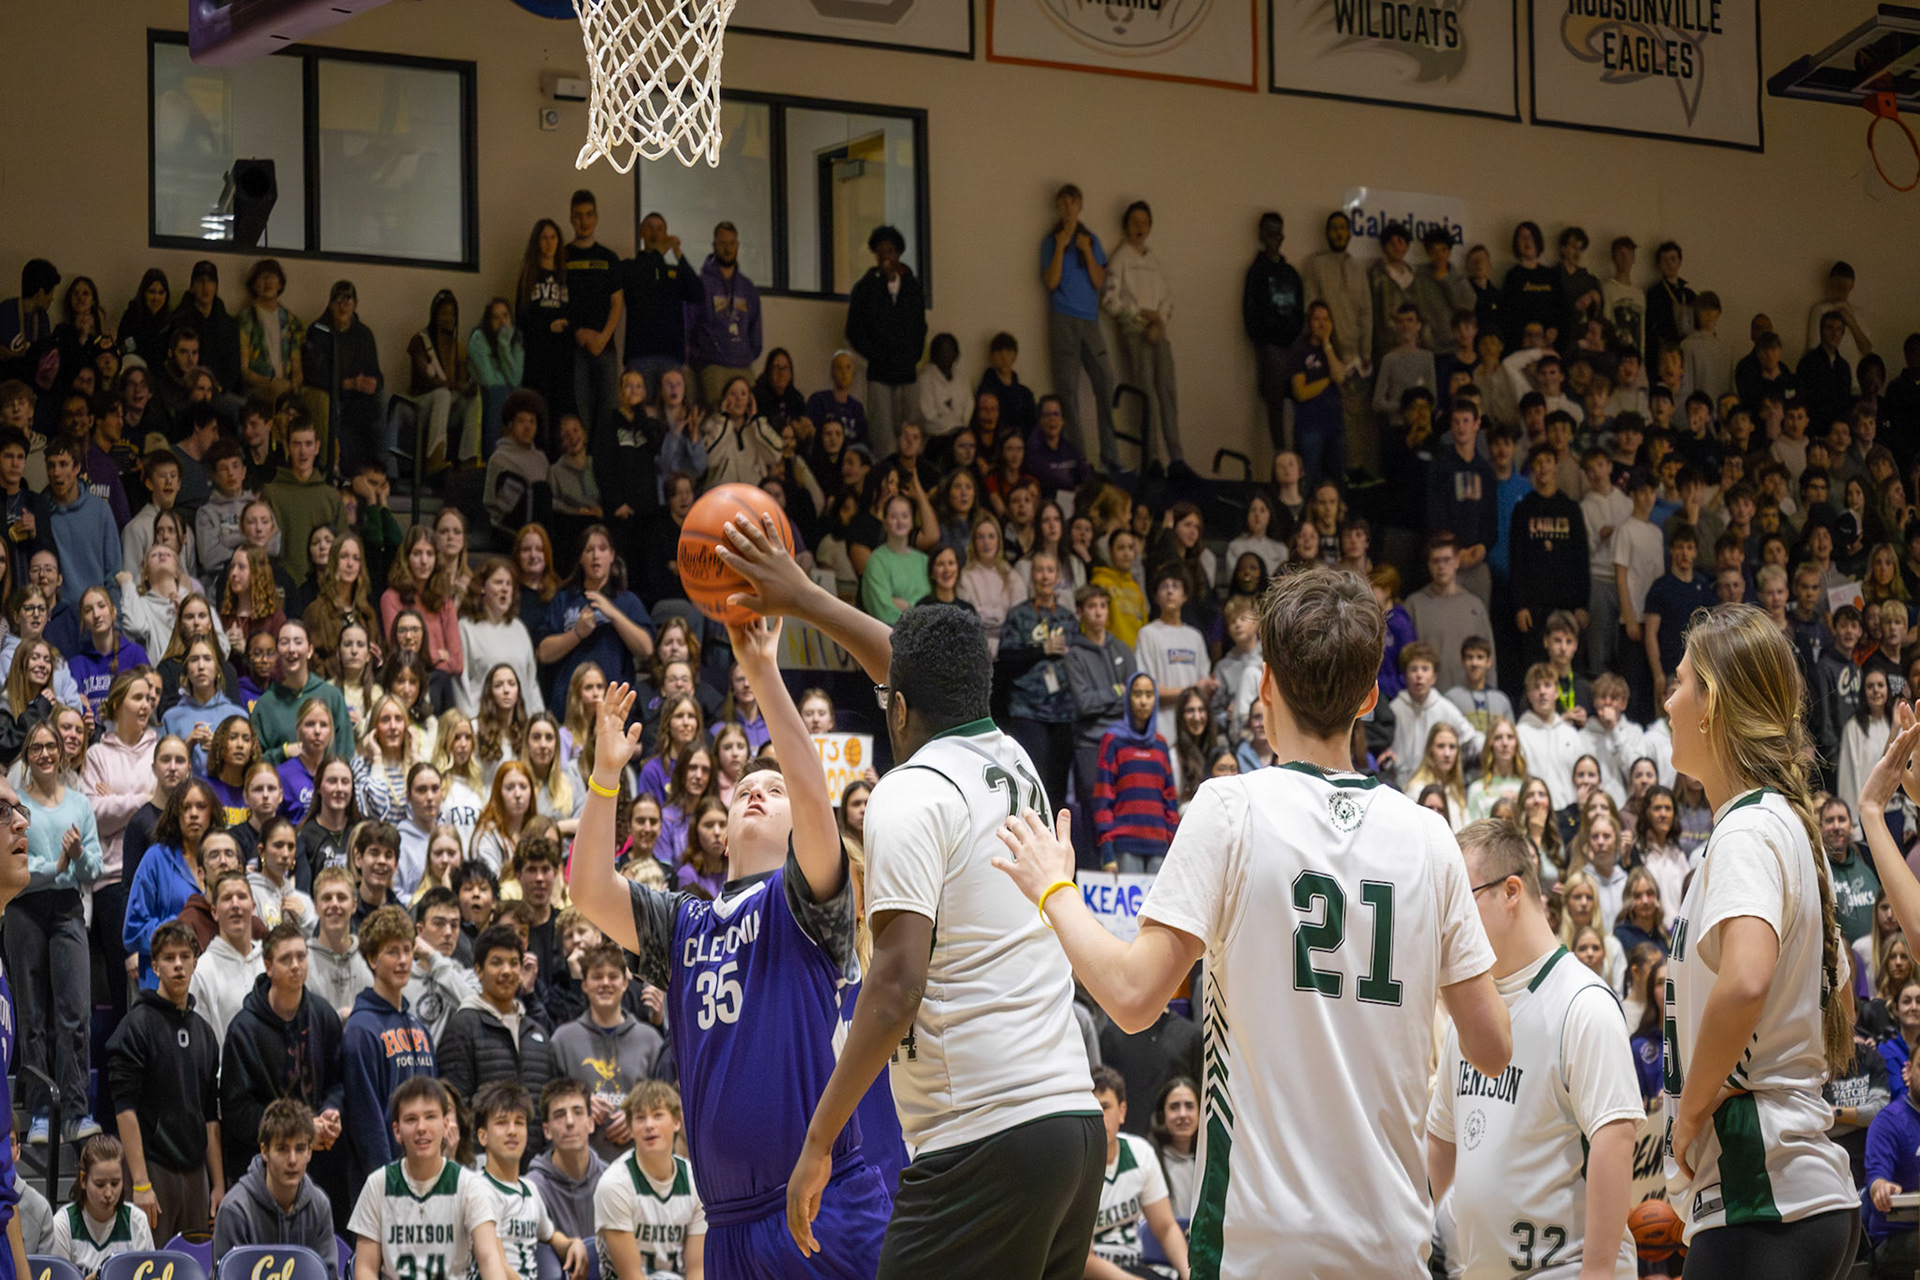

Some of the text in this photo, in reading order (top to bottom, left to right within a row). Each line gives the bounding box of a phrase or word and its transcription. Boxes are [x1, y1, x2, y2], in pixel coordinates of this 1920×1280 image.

[1334, 0, 1459, 49] WILDCATS
[1603, 31, 1693, 79] EAGLES
[1350, 208, 1465, 247] Caldoia
[1082, 884, 1153, 918] KEAG
[1291, 869, 1403, 1007] 21
[696, 960, 744, 1031] 35
[388, 1223, 454, 1245] JENISON
[1508, 1218, 1569, 1273] 32
